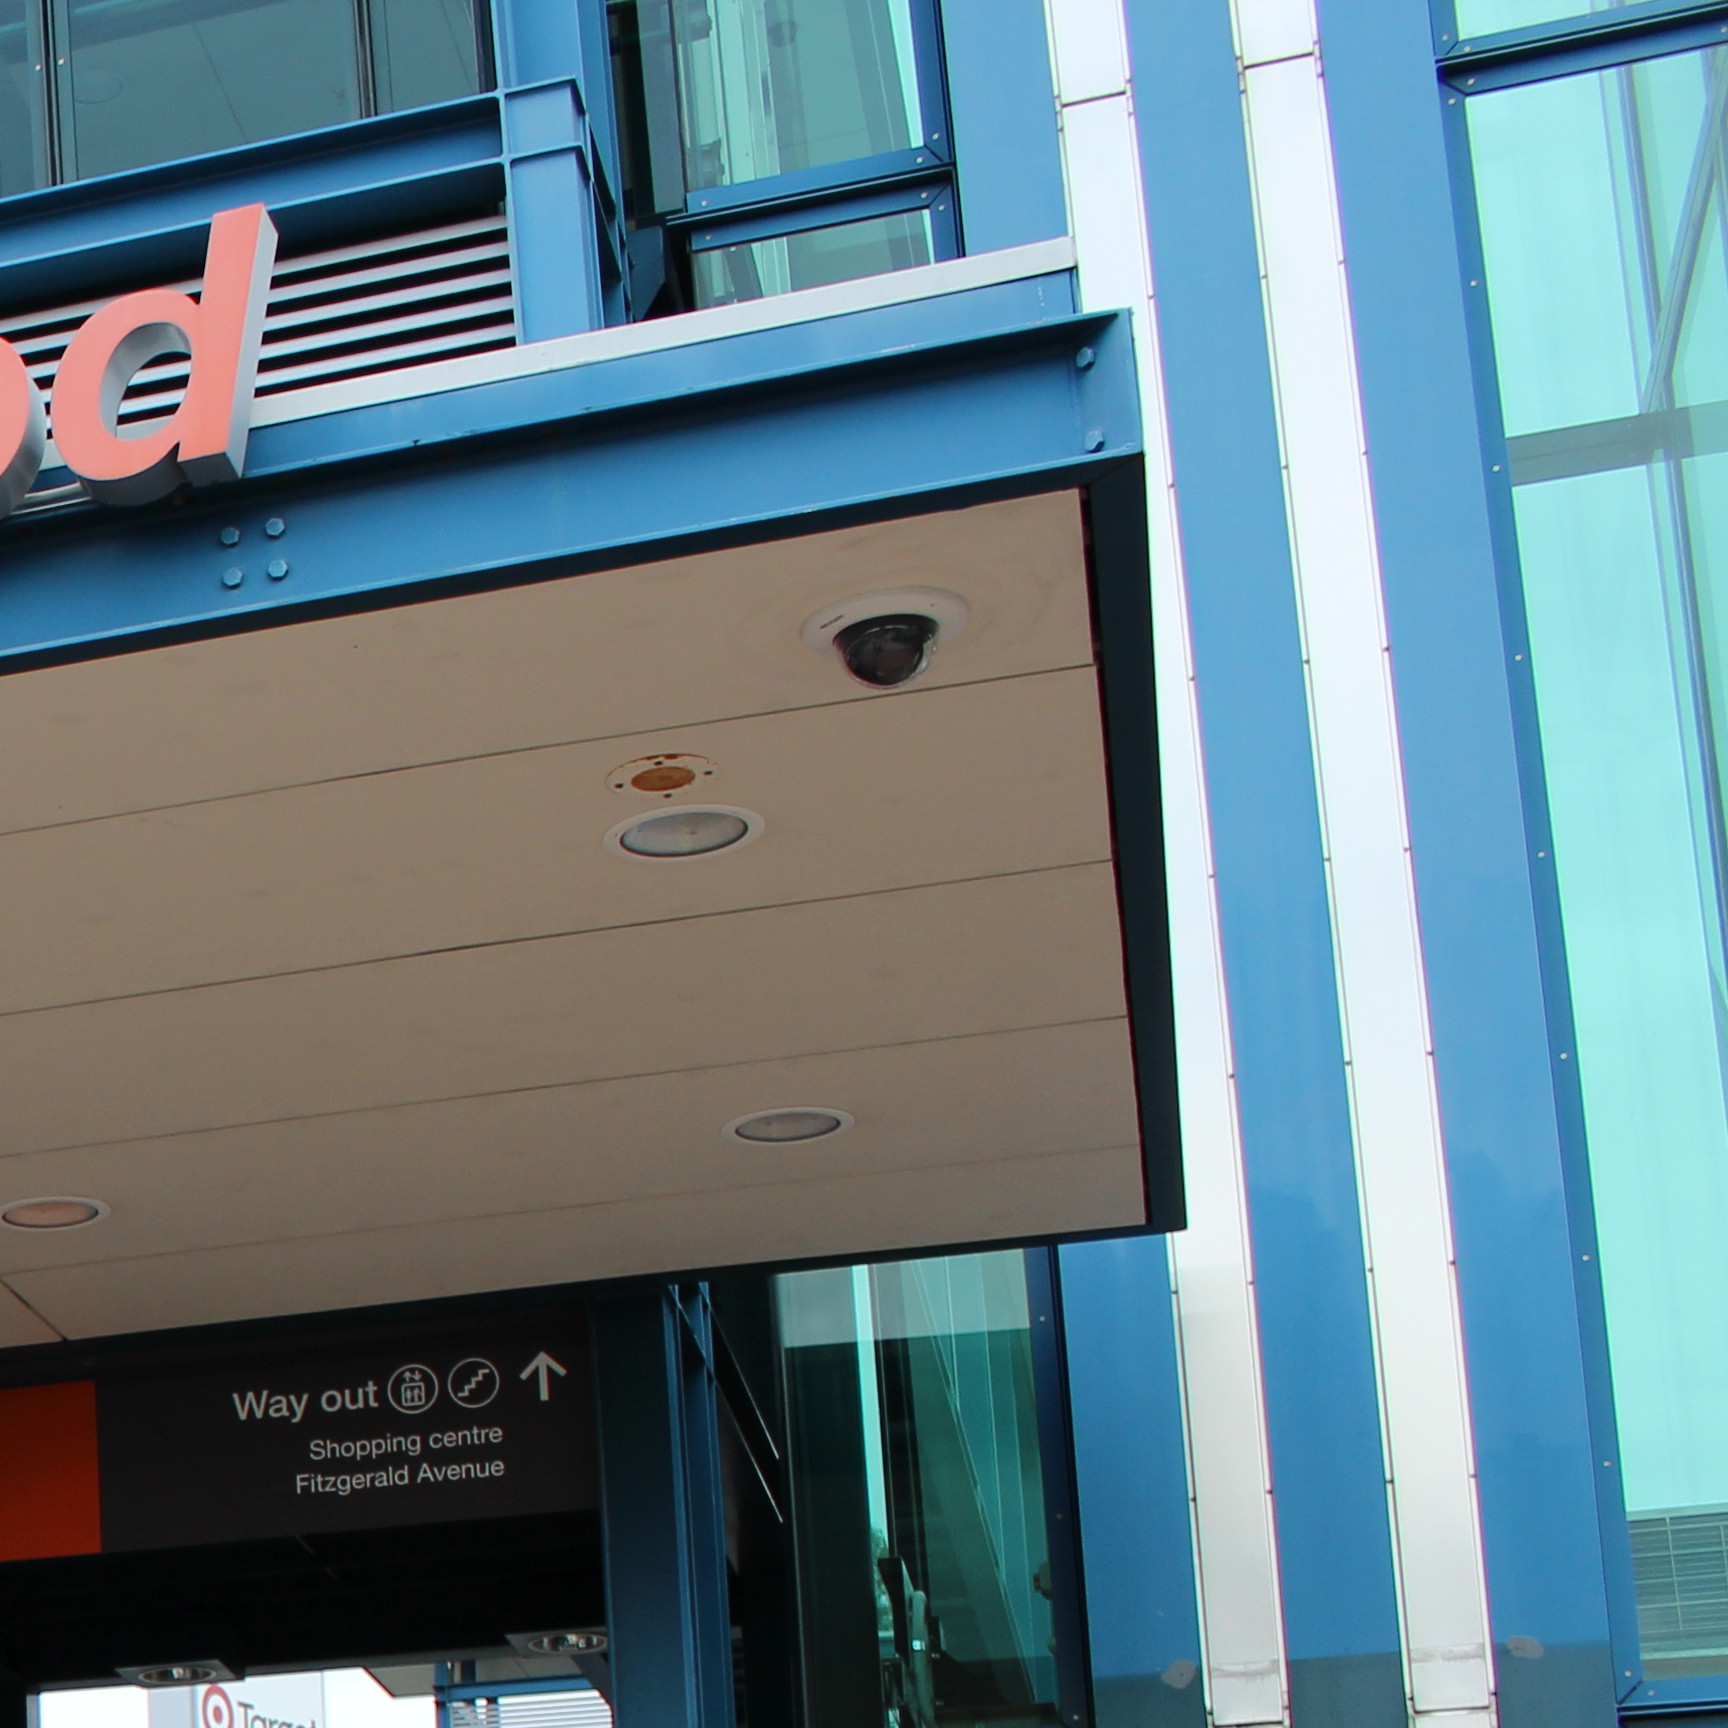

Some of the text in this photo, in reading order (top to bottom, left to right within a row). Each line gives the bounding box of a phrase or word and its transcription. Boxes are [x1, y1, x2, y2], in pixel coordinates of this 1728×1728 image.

[232, 1381, 379, 1423] Way out
[310, 1426, 503, 1460] Shopping centre
[296, 1460, 505, 1496] Fitzgerald Avenue
